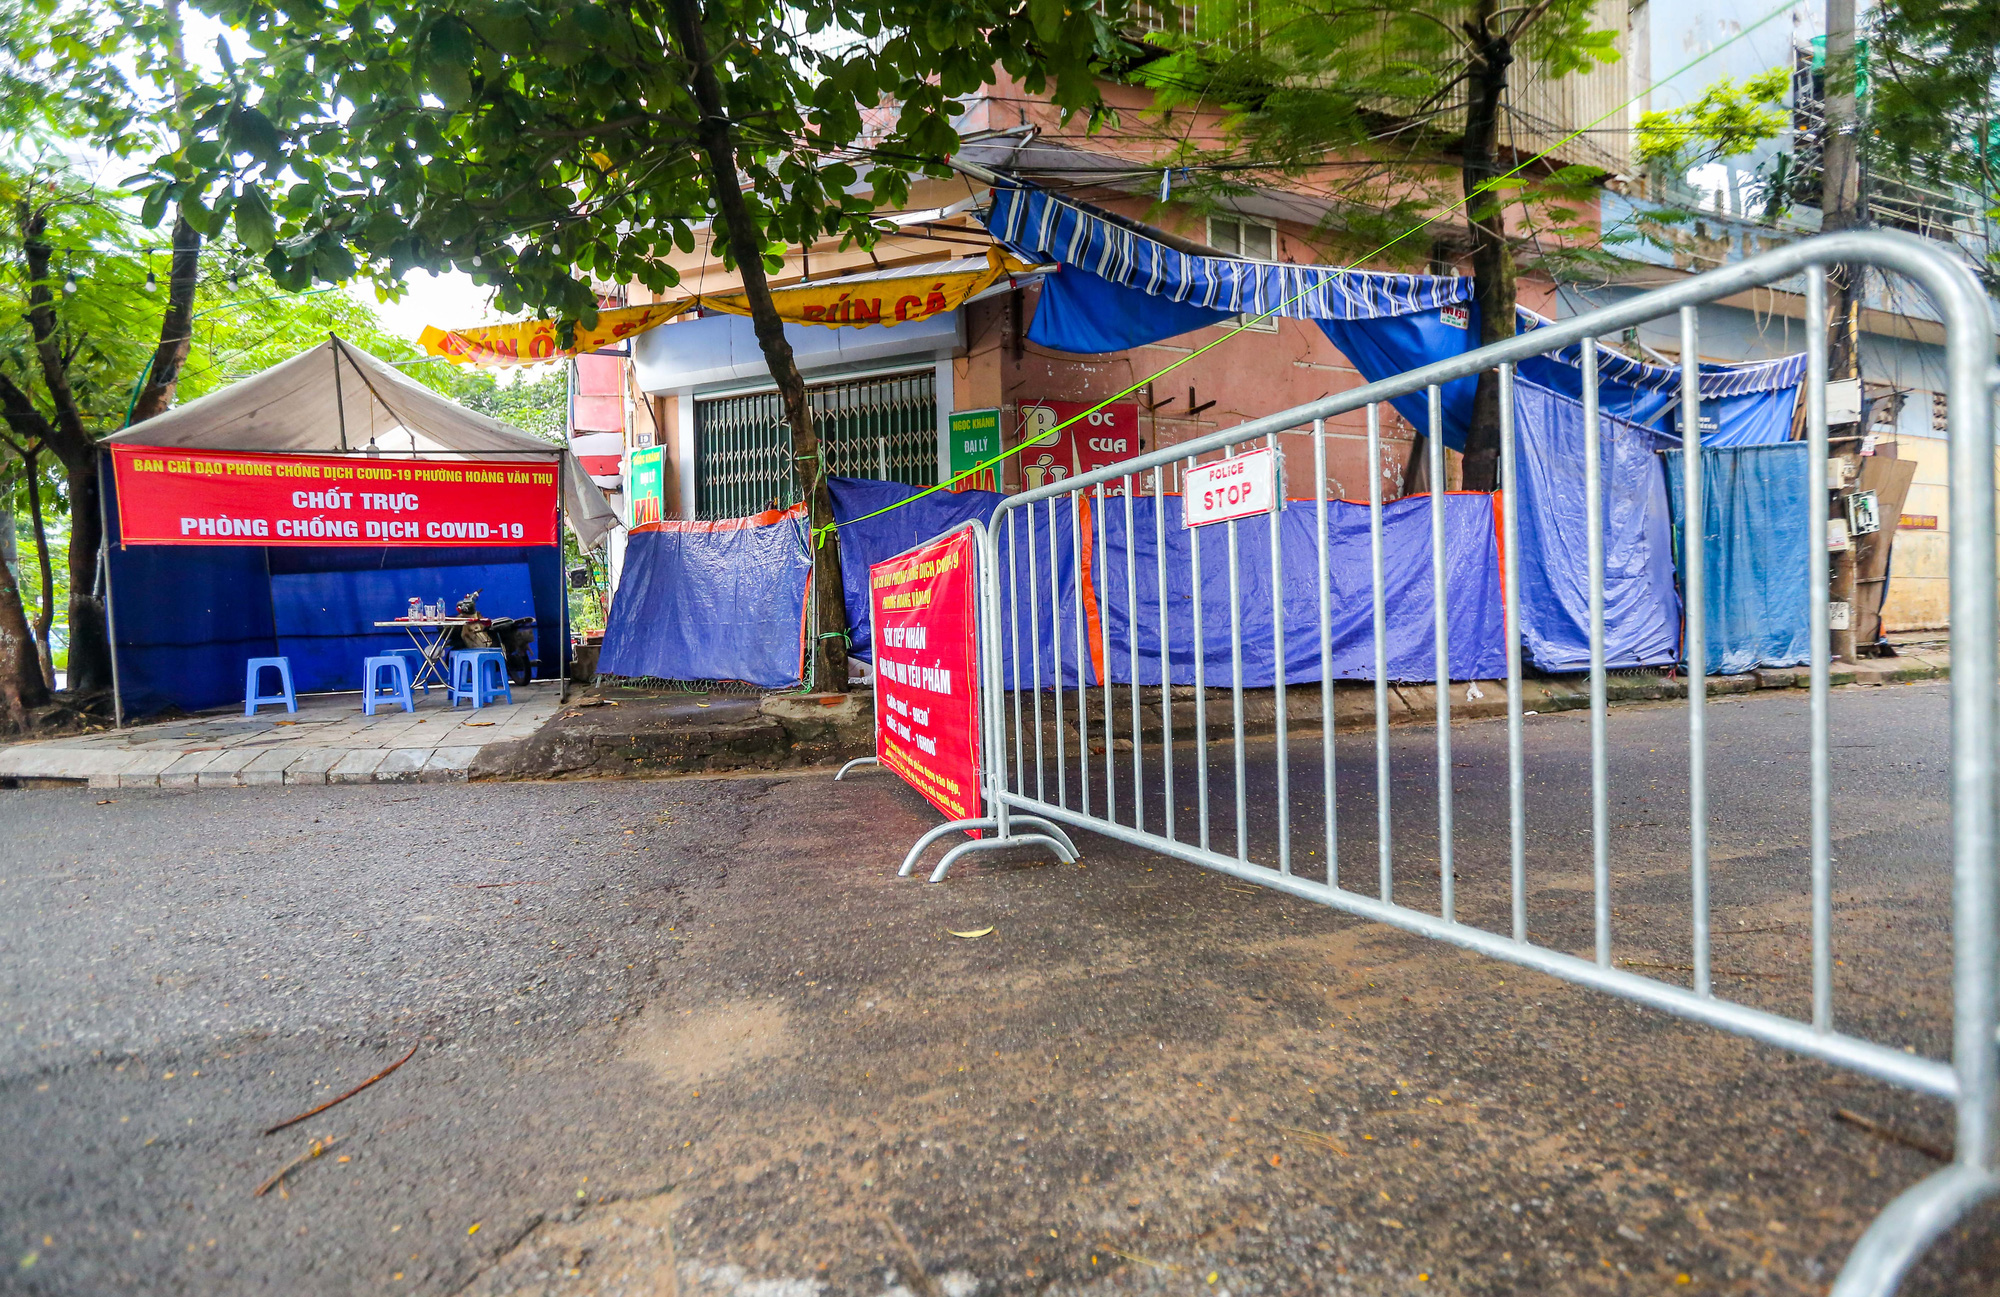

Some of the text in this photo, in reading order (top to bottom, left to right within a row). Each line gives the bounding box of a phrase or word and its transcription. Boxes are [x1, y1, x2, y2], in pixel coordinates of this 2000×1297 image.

[894, 283, 946, 321] CÁ
[528, 323, 578, 358] Ố
[953, 416, 995, 432] NGỌC KHÁNH
[964, 436, 988, 455] ĐẠI LÝ
[1088, 437, 1127, 453] CUA
[133, 457, 553, 487] BAN CHỈ ĐẠO PHÒNG CHỐNG DỊCH COVID-19 PHƯỜNG HOÀNG VĂN THỤ
[954, 460, 997, 493] MÍA
[292, 486, 419, 514] CHỐT TRỰC
[634, 490, 661, 527] MÍA
[1204, 481, 1252, 511] STOP
[180, 513, 524, 542] PHÒNG CHỐNG DỊCH COVID-19
[919, 560, 935, 582] DỊCH
[905, 622, 926, 654] NHẬN
[907, 658, 921, 689] YẾU
[922, 658, 951, 695] PHẨM
